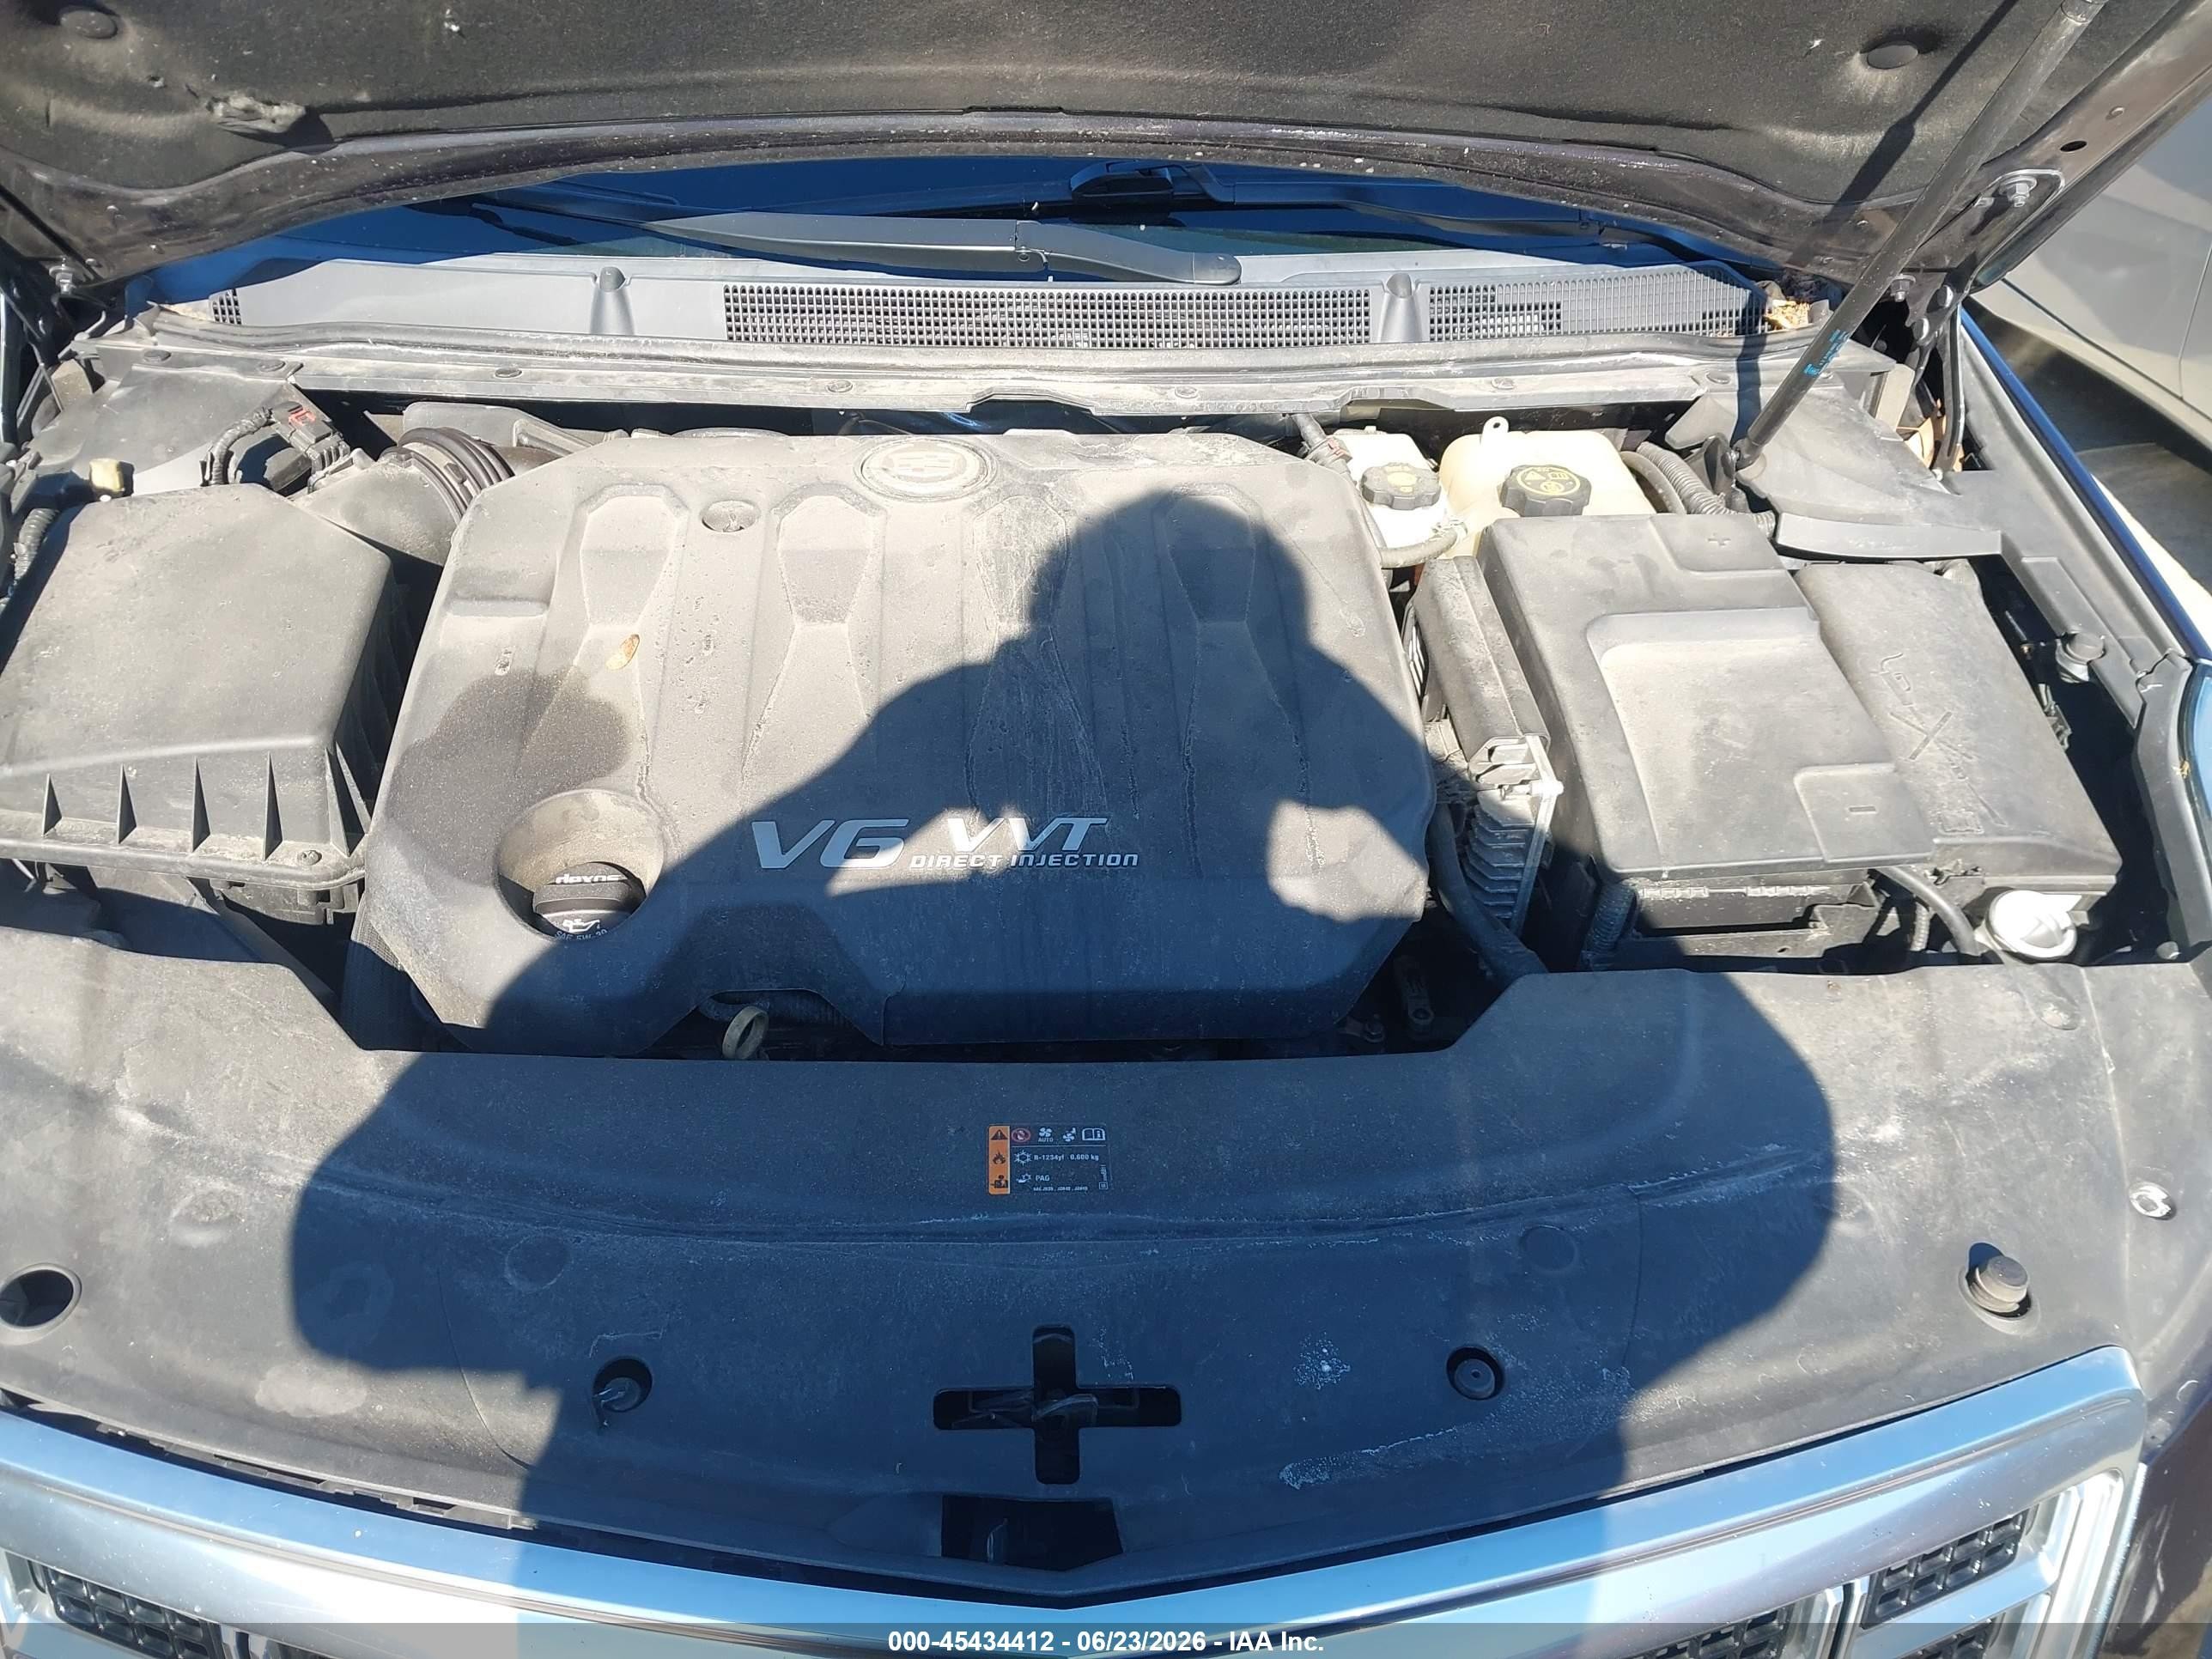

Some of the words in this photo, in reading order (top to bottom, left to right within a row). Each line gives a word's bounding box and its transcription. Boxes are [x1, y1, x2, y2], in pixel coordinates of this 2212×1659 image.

[750, 818, 910, 870] V6
[947, 817, 1109, 853] VVT
[909, 854, 1003, 870] DIRECT
[1010, 854, 1139, 869] INJECTION
